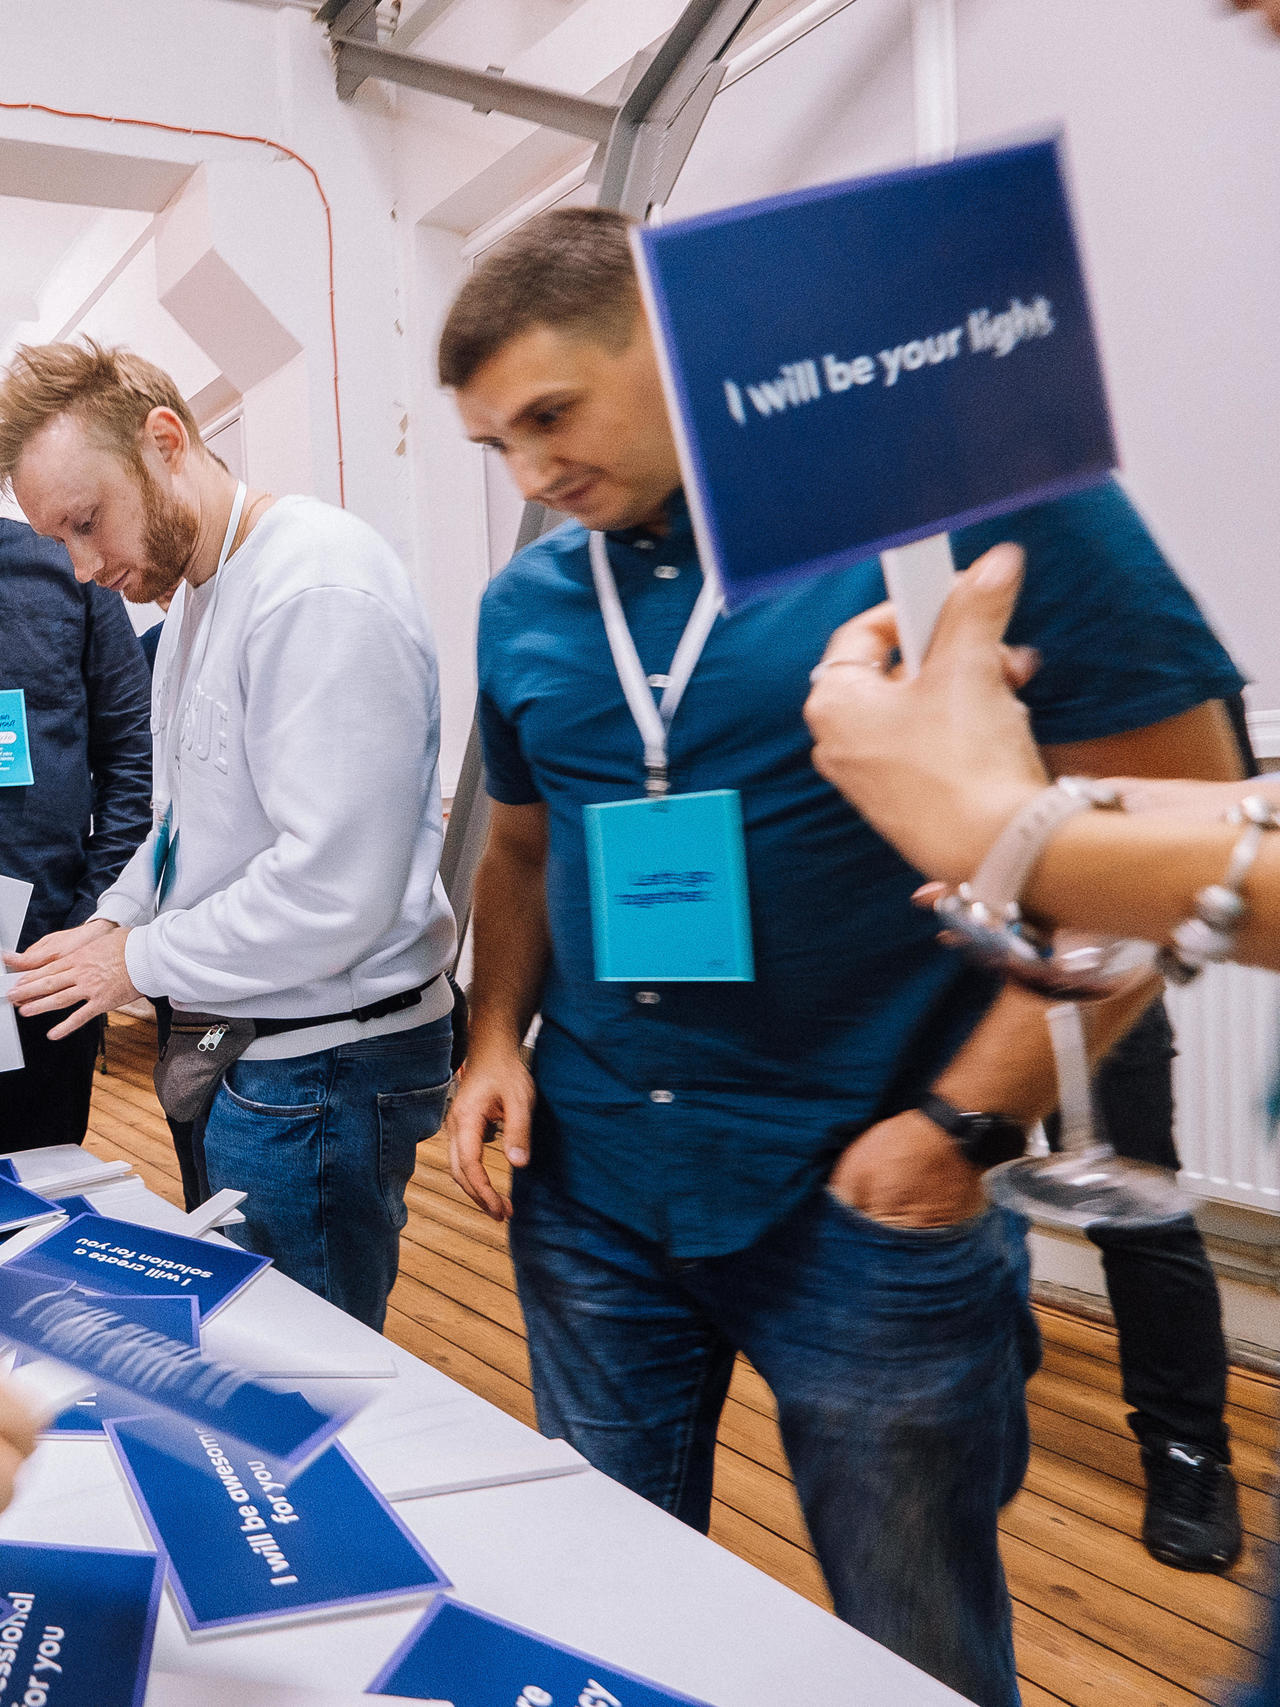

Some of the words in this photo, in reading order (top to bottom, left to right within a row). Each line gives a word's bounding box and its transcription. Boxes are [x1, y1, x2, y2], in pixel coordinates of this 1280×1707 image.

[723, 379, 747, 426] I
[746, 359, 821, 418] will
[823, 353, 875, 393] be
[878, 326, 963, 387] your
[967, 296, 1055, 357] light
[76, 1238, 111, 1250] you
[108, 1246, 137, 1259] for
[88, 1251, 146, 1272] create
[138, 1253, 214, 1278] solution
[144, 1268, 180, 1282] will
[180, 1278, 192, 1287] I
[247, 1460, 286, 1492] you
[238, 1505, 267, 1532] be
[267, 1494, 299, 1524] for
[246, 1533, 290, 1573] will
[270, 1575, 299, 1586] I
[33, 1625, 65, 1674] you
